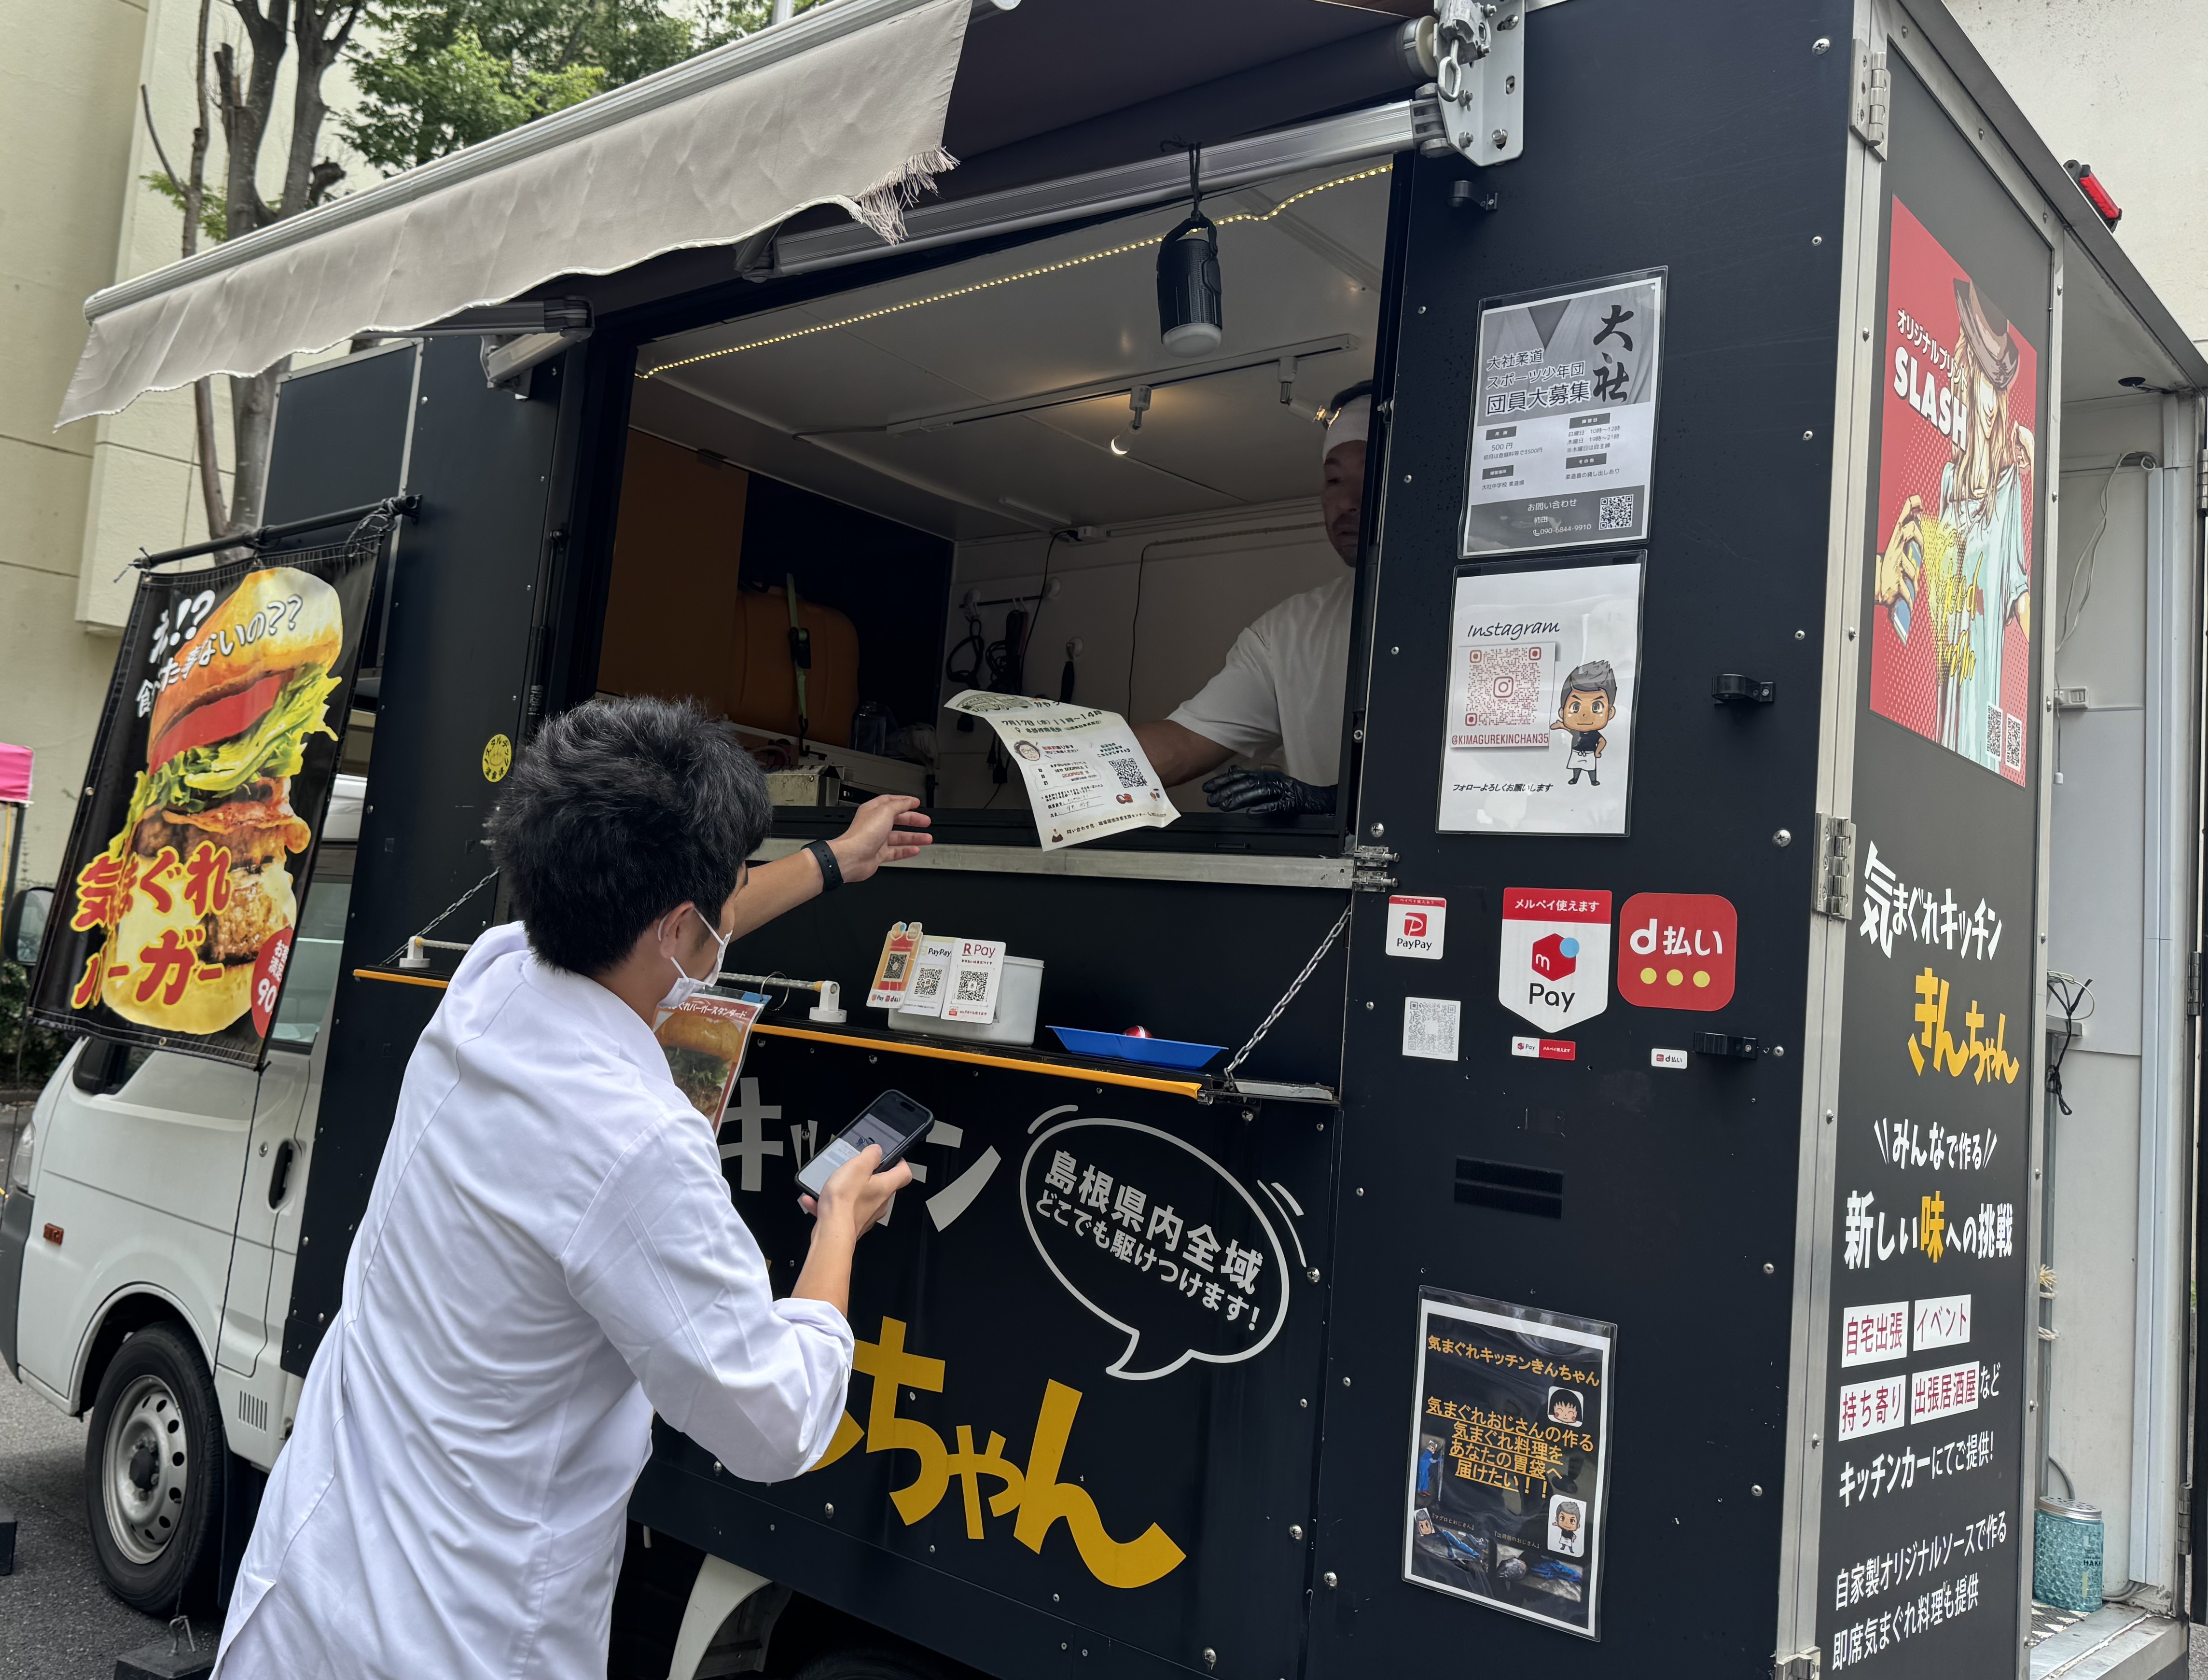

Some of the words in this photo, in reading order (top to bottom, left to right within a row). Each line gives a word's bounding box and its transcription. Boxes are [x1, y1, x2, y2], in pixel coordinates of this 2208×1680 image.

[1486, 349, 1543, 370] 大社柔道
[1593, 305, 1634, 403] 大社
[1897, 309, 1968, 391] オリジナルプリント
[1486, 361, 1584, 389] スポーツ少年団
[1487, 380, 1590, 415] 団員大募集
[1894, 346, 1968, 451] SLASH
[1527, 498, 1577, 512] お問い合わせ
[1540, 524, 1591, 535] 090-6844-9910
[1467, 621, 1560, 640] Instagram
[1451, 733, 1549, 746] @KIMAGUREKINCHAN35
[1453, 782, 1553, 793] フォローよろしくお願いします
[1514, 898, 1599, 913] メルペイ使えます
[1860, 840, 2002, 960] 気まぐれキッチン
[928, 948, 952, 958] PayPay
[974, 944, 996, 958] Pay
[1397, 938, 1432, 951] PayPay
[1629, 918, 1722, 956] d払い
[1529, 983, 1575, 1013] Pay
[1908, 967, 2020, 1085] きんちゃん
[1892, 1118, 1982, 1170] みんなで作る
[1044, 1149, 1264, 1295] 島根県内全域
[1844, 1190, 2013, 1270] 新しい味への挑戦
[1036, 1189, 1261, 1331] どこでも駆けつけます!
[1846, 1312, 1903, 1357] 自宅出張
[1916, 1303, 1967, 1343] イベント
[1428, 1335, 1600, 1387] 気まぐれキッチンきんちゃん
[1842, 1384, 1902, 1433] 持ち寄り
[1914, 1369, 1976, 1416] 出張居酒屋
[1980, 1362, 2001, 1399] など
[1427, 1396, 1594, 1452] 気まぐれおじさんの作る
[1453, 1421, 1563, 1464] 気まぐれ料理を
[1449, 1439, 1562, 1480] あなたの胃袋へ
[1839, 1430, 1994, 1508] キッチンカーにてご提供!
[1835, 1511, 2006, 1611] 自家製オリジナルソースで作る
[1832, 1572, 1979, 1670] 即席気まぐれ料理も提供
